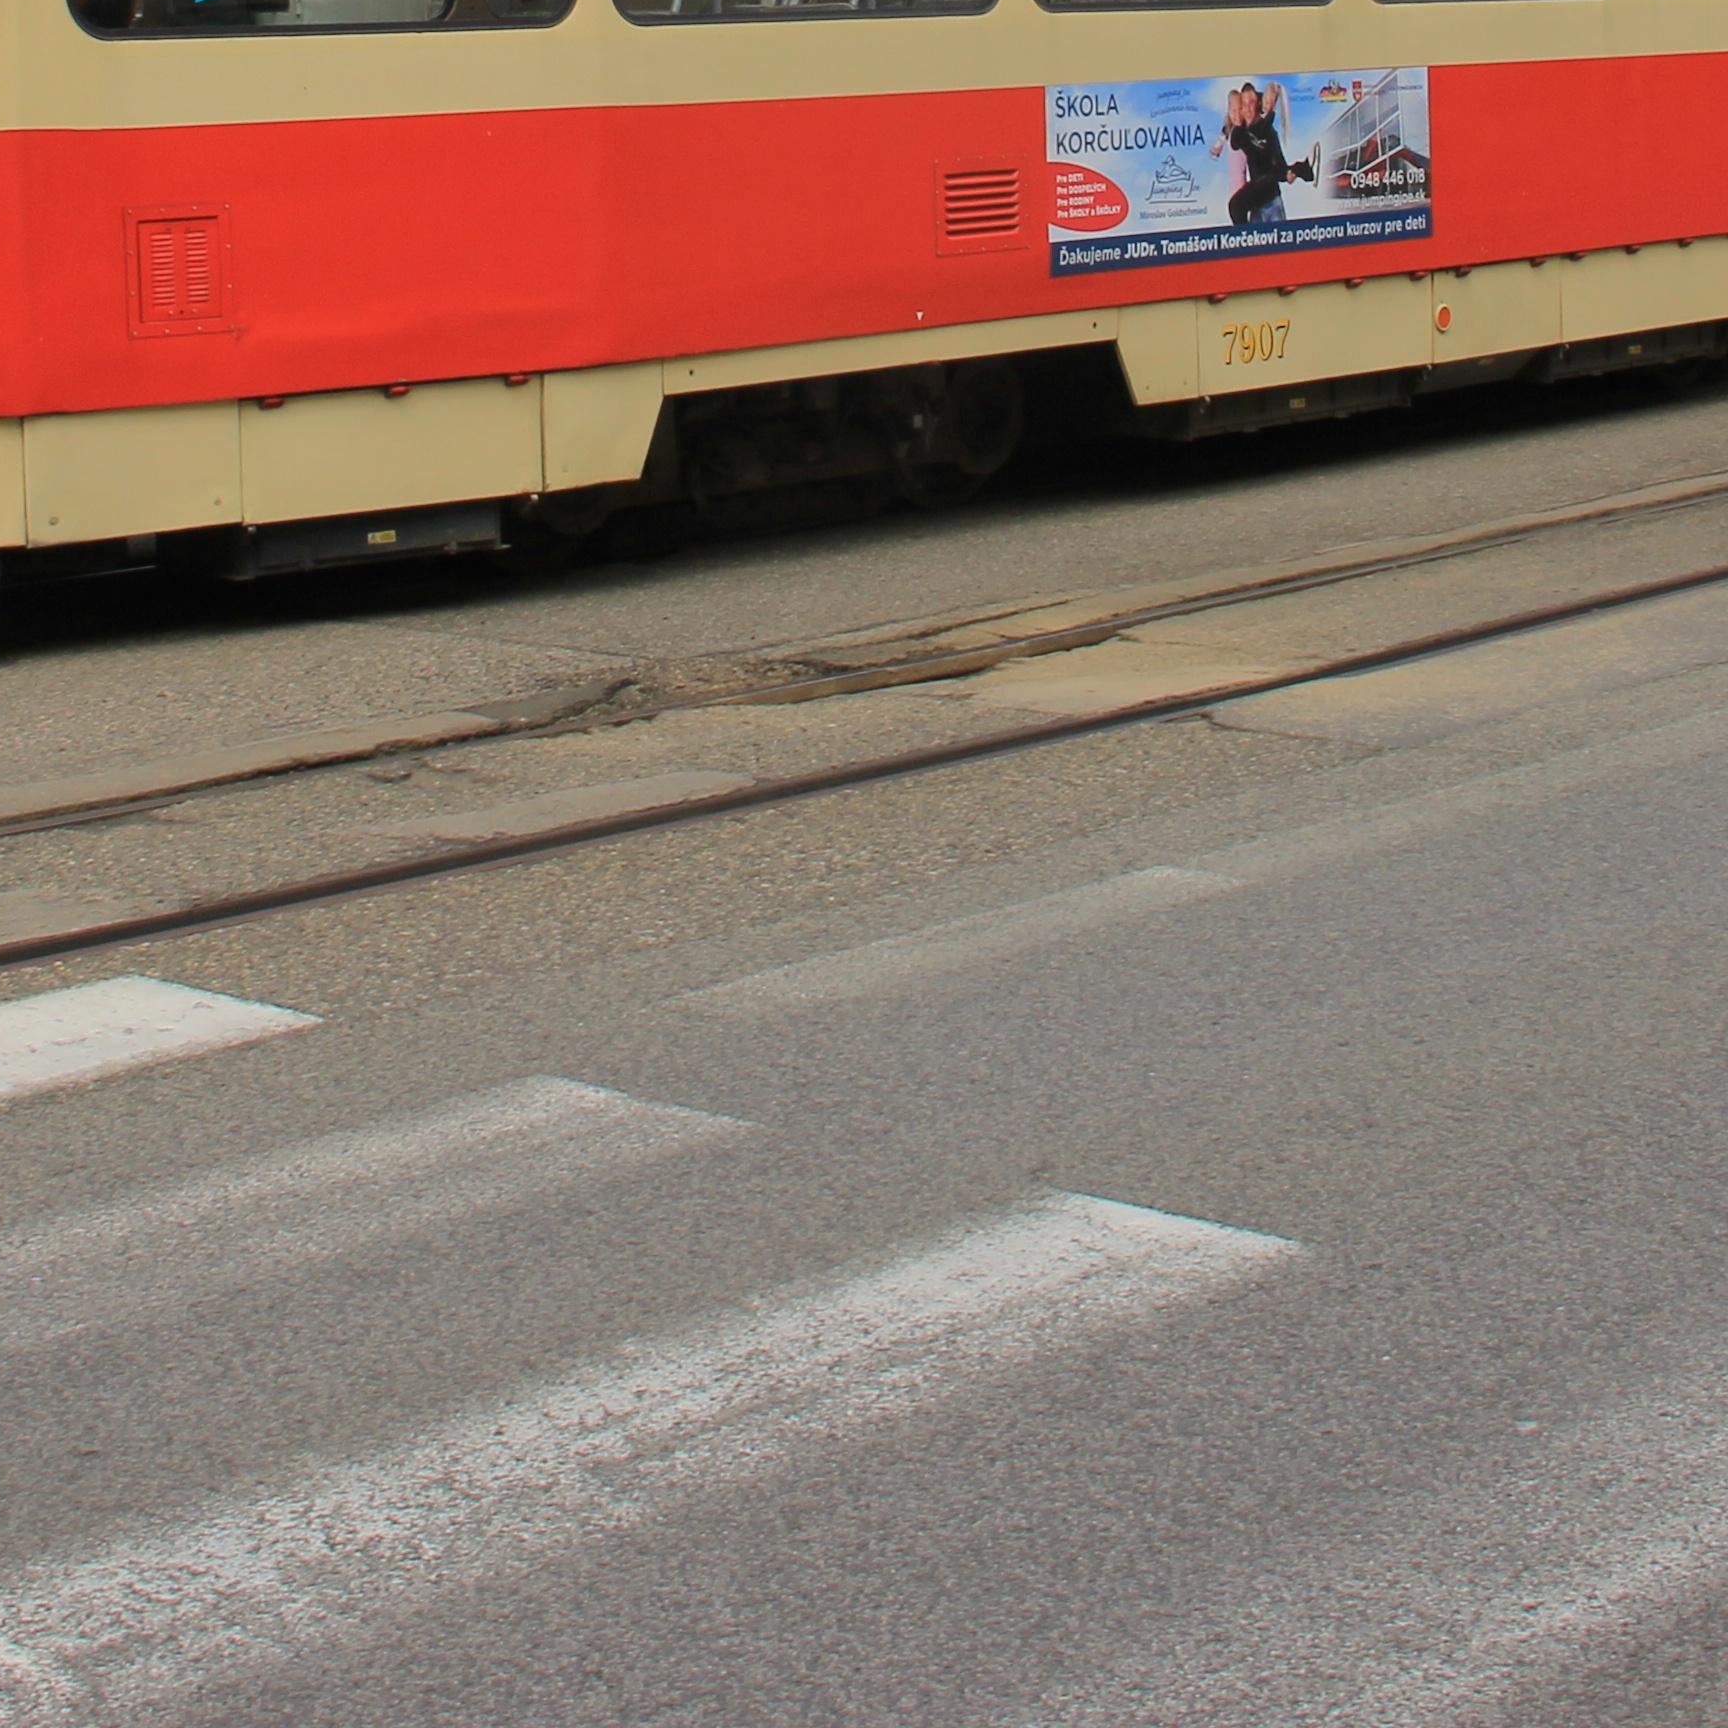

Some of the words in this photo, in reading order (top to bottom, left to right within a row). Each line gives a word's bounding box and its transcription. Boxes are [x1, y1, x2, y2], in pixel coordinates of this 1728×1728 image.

[1055, 90, 1119, 118] ŠKOLA
[1056, 123, 1205, 155] KORČUĽOVANIA
[1056, 175, 1067, 183] Pre
[1351, 172, 1380, 189] 0948
[1382, 170, 1404, 185] 446
[1406, 168, 1426, 184] 018
[1056, 186, 1067, 195] Pre
[1056, 198, 1067, 207] Pre
[1069, 196, 1094, 206] RODINY
[1056, 210, 1068, 219] Pre
[1059, 245, 1121, 265] Ďakujeme
[1124, 241, 1158, 259] JUDr.
[1160, 234, 1218, 255] Tomášovi
[1220, 227, 1278, 249] Korčekovi
[1280, 230, 1293, 243] za
[1296, 223, 1345, 243] podporu
[1347, 219, 1383, 237] kurzov
[1384, 219, 1403, 235] pre
[1405, 214, 1426, 231] deti
[1221, 319, 1291, 365] 7907
